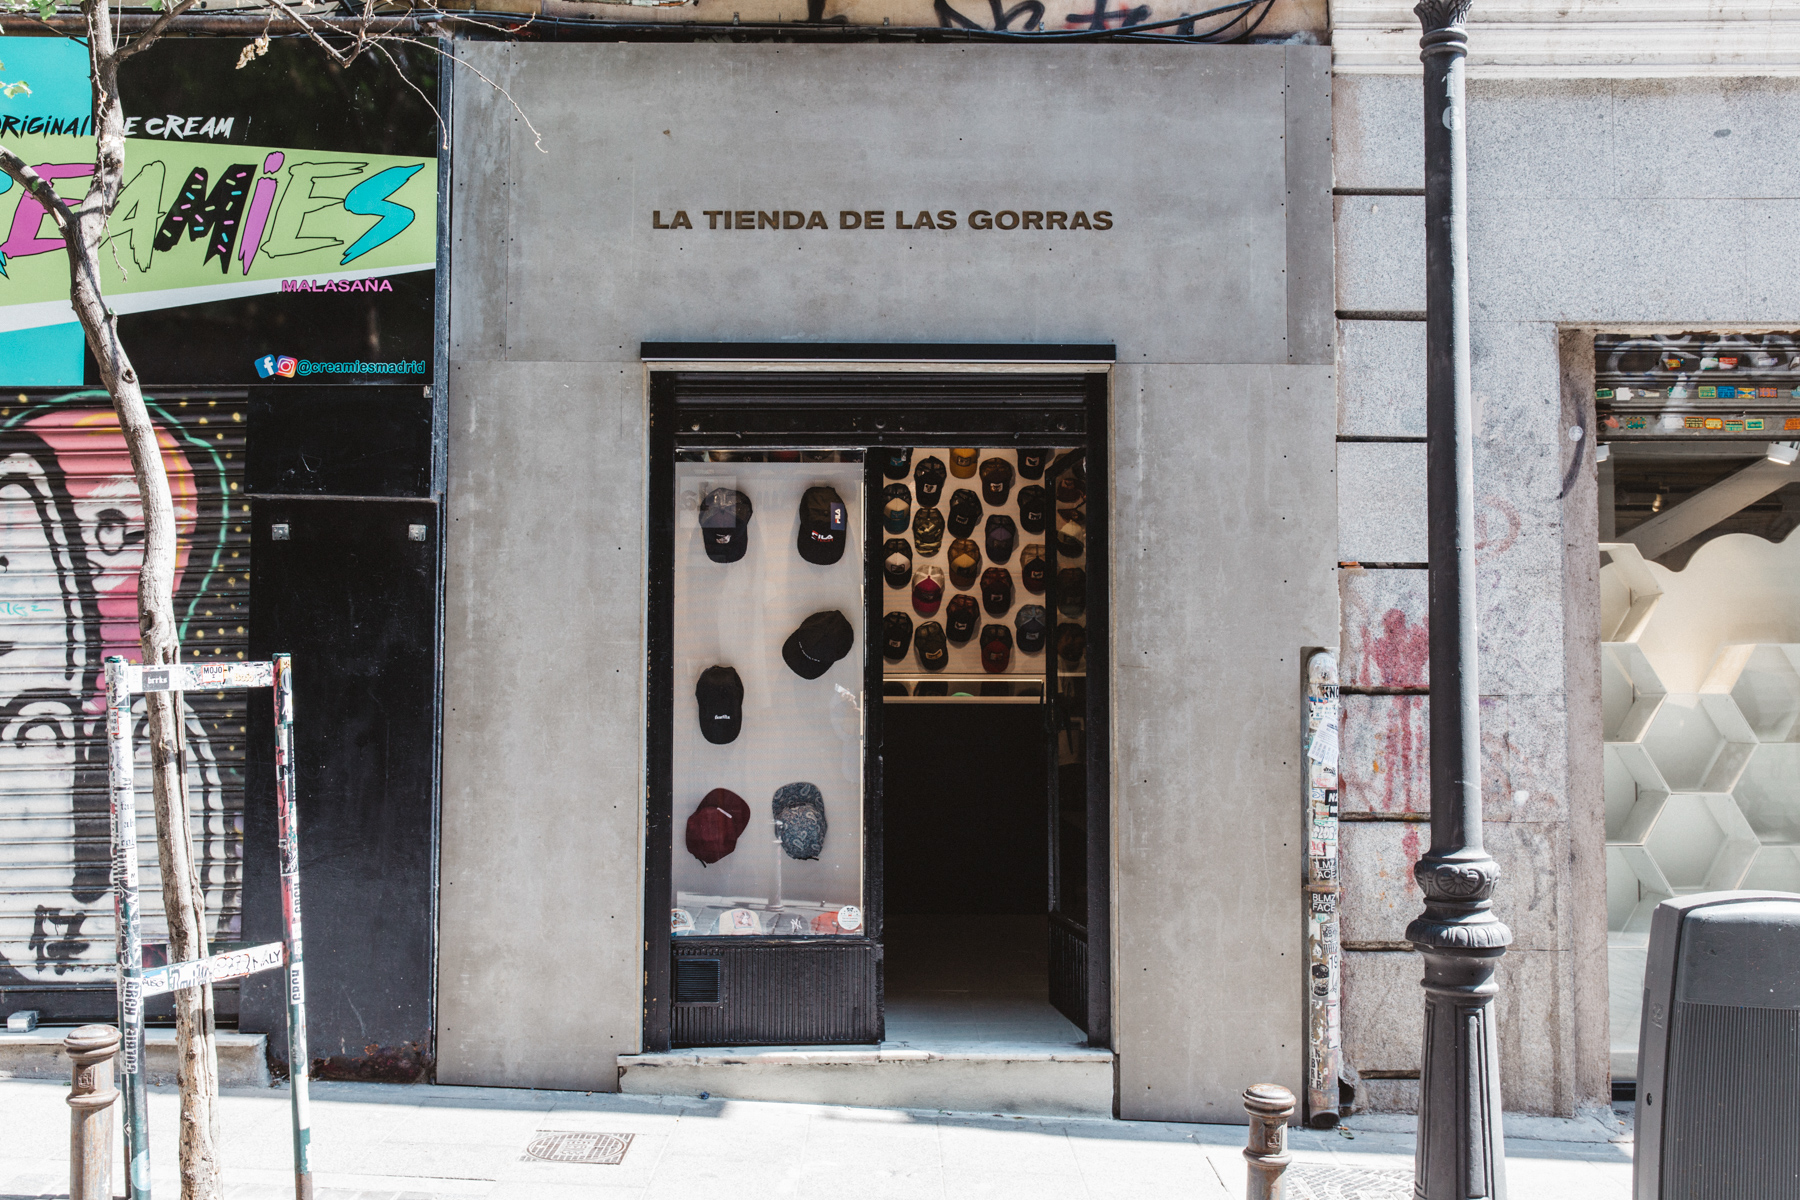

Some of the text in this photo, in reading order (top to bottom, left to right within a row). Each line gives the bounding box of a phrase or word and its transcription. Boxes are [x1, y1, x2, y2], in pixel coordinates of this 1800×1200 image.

[145, 114, 234, 140] CREAM
[652, 210, 1113, 230] LA TIENDA DE LAS GORRAS
[281, 277, 393, 292] MALASAÑA
[297, 360, 426, 376] @creamiesmadrid
[811, 530, 834, 541] FILA
[203, 666, 223, 674] MOJO
[1312, 893, 1336, 902] BLMZ
[1312, 904, 1336, 913] FACE
[125, 981, 139, 1016] GRCH
